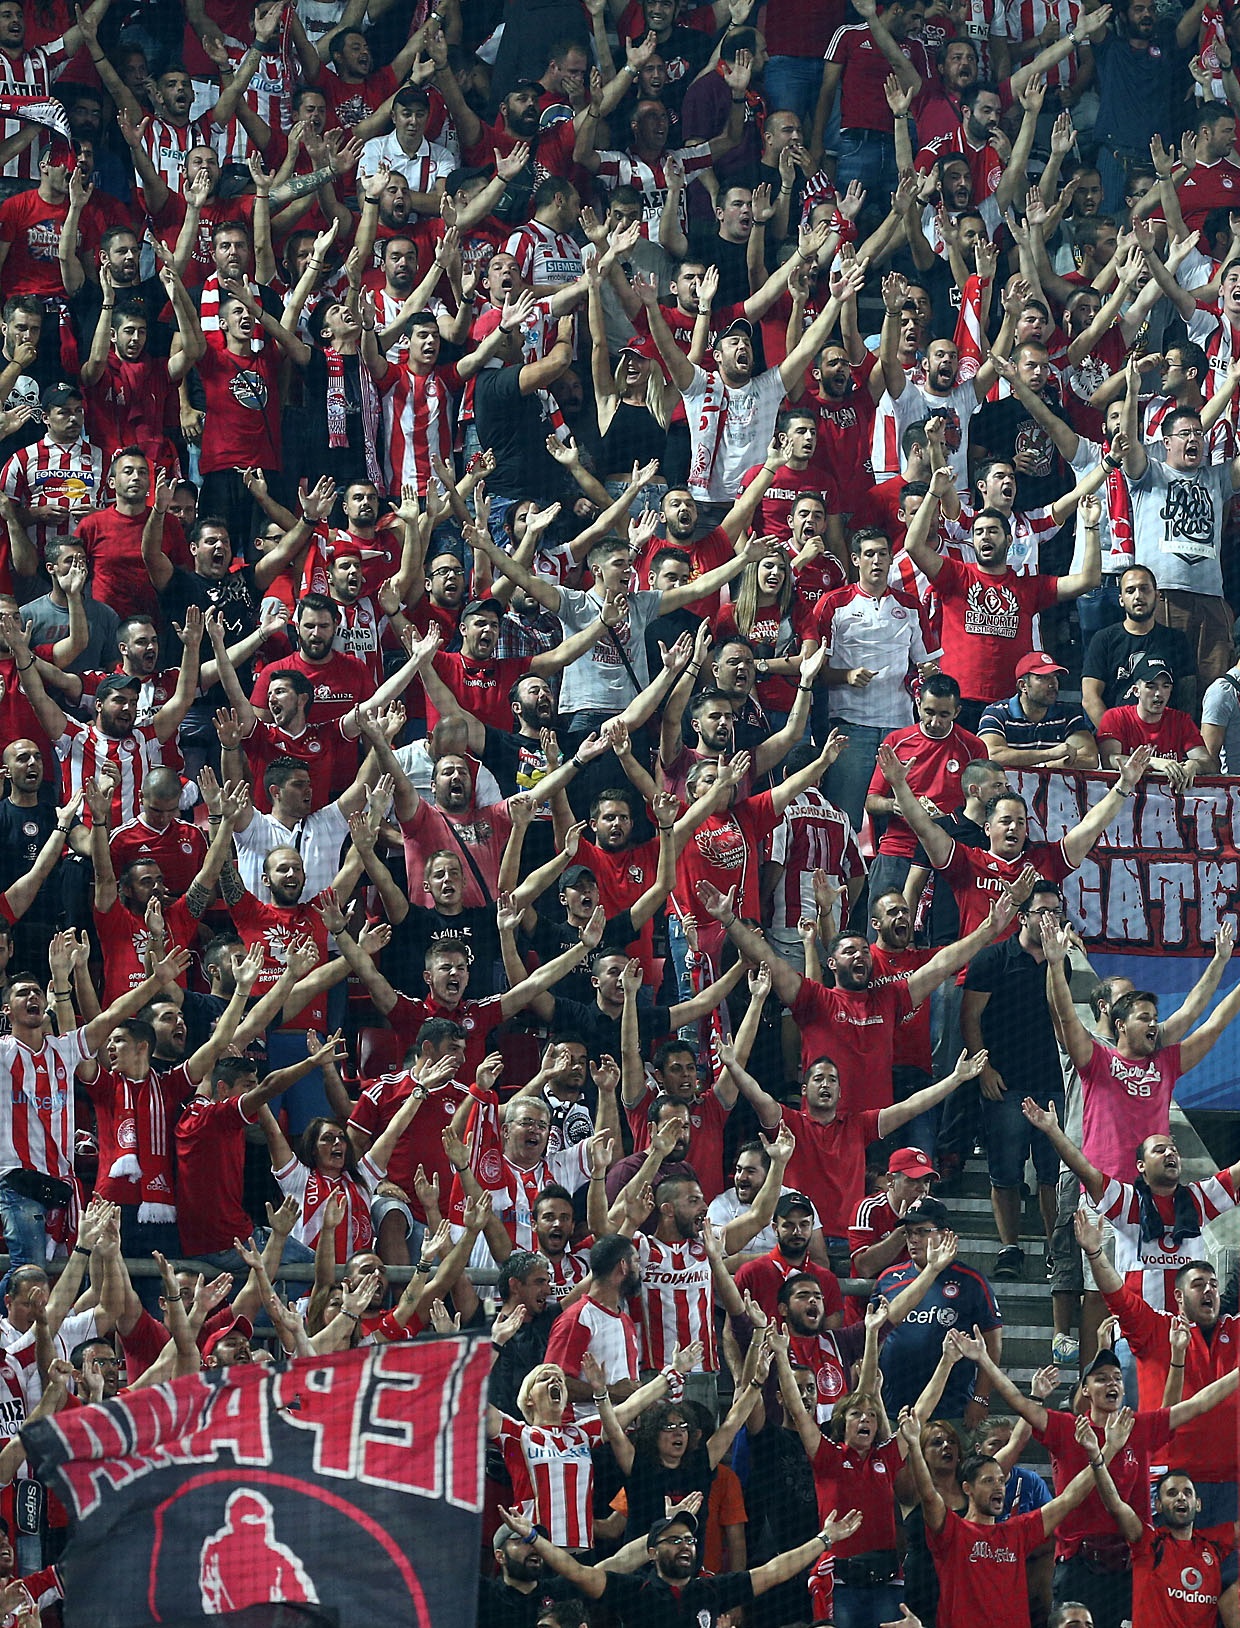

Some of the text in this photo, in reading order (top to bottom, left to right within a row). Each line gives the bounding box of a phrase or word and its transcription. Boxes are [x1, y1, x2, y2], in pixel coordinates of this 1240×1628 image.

[161, 148, 187, 161] SIEM
[965, 611, 1019, 628] RED NORTH
[1060, 856, 1240, 945] GATE
[1141, 1252, 1193, 1265] vodafon
[24, 1484, 38, 1530] Super
